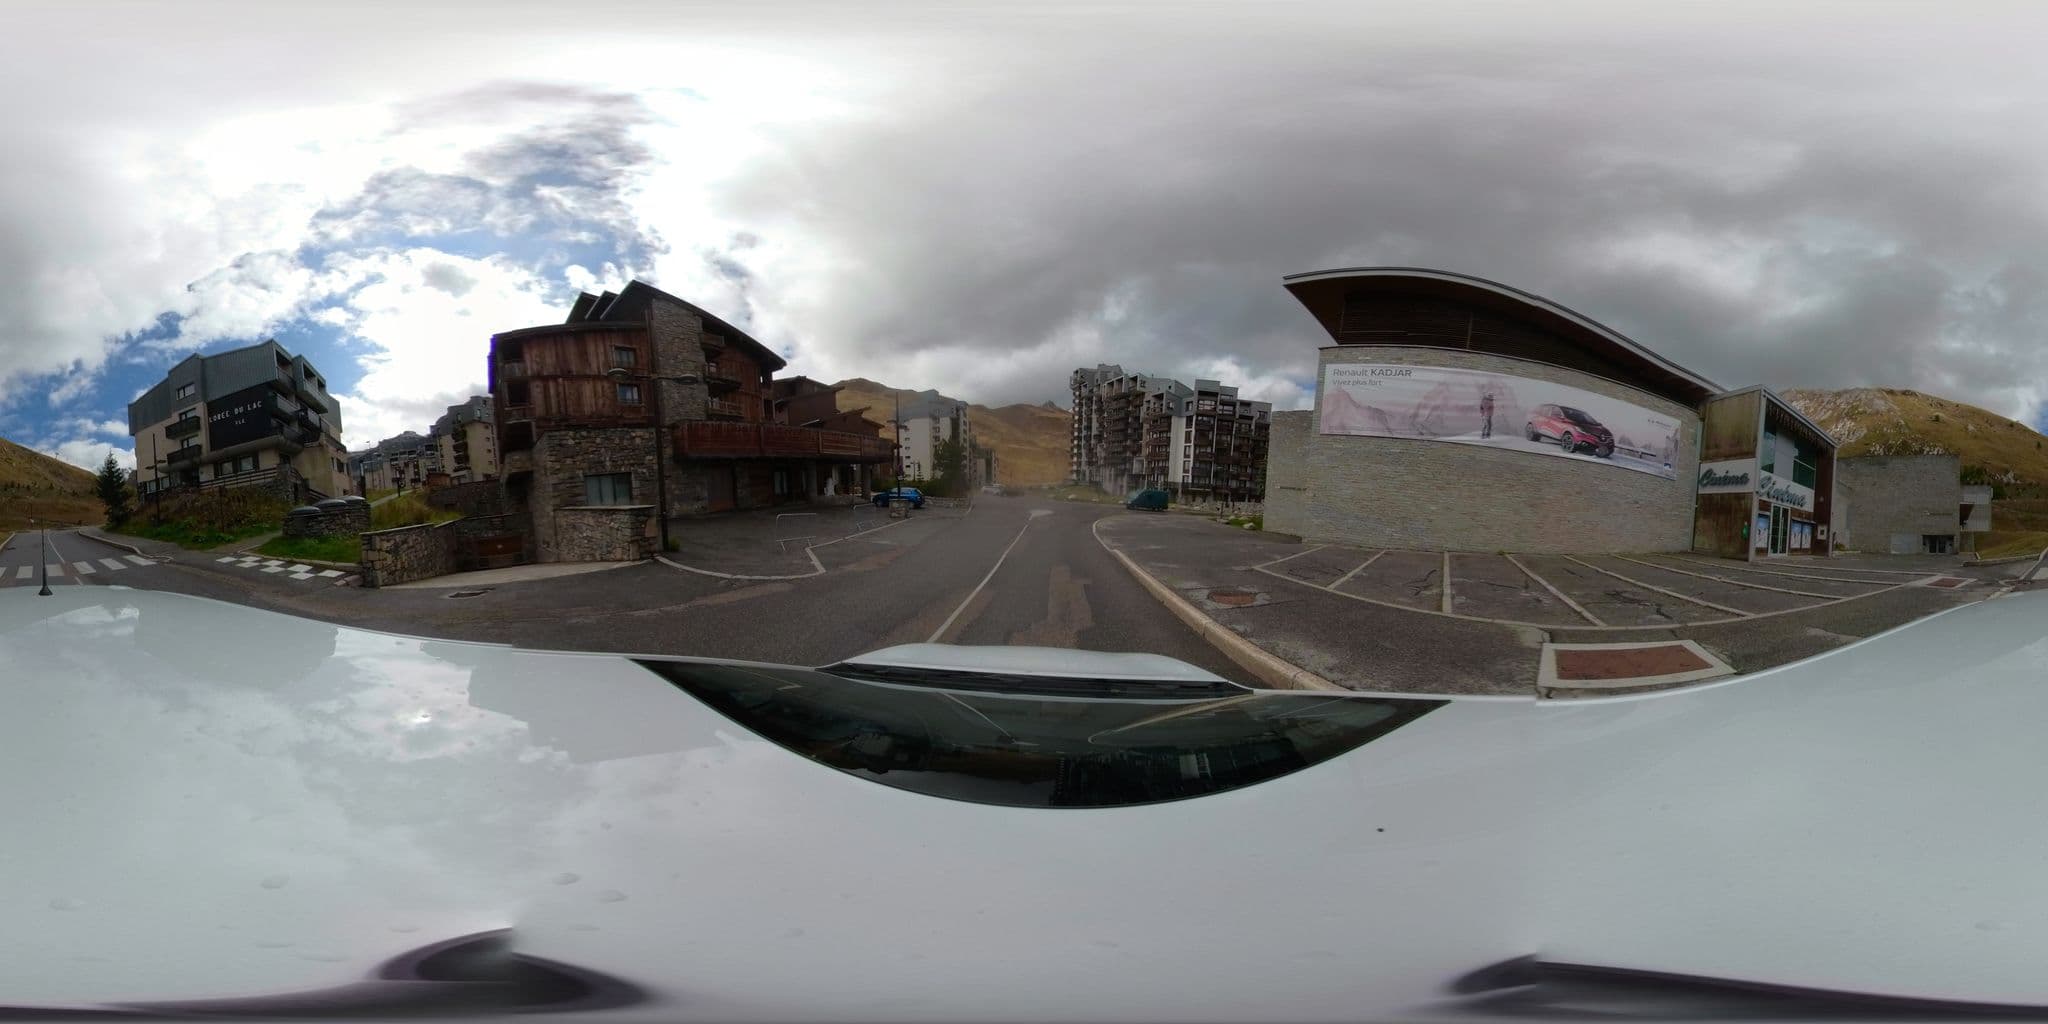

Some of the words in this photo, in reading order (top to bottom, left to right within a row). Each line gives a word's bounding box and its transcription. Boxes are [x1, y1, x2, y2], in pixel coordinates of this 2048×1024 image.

[1333, 368, 1368, 377] Renault
[1370, 368, 1412, 377] KADJAR
[247, 400, 262, 411] LAC
